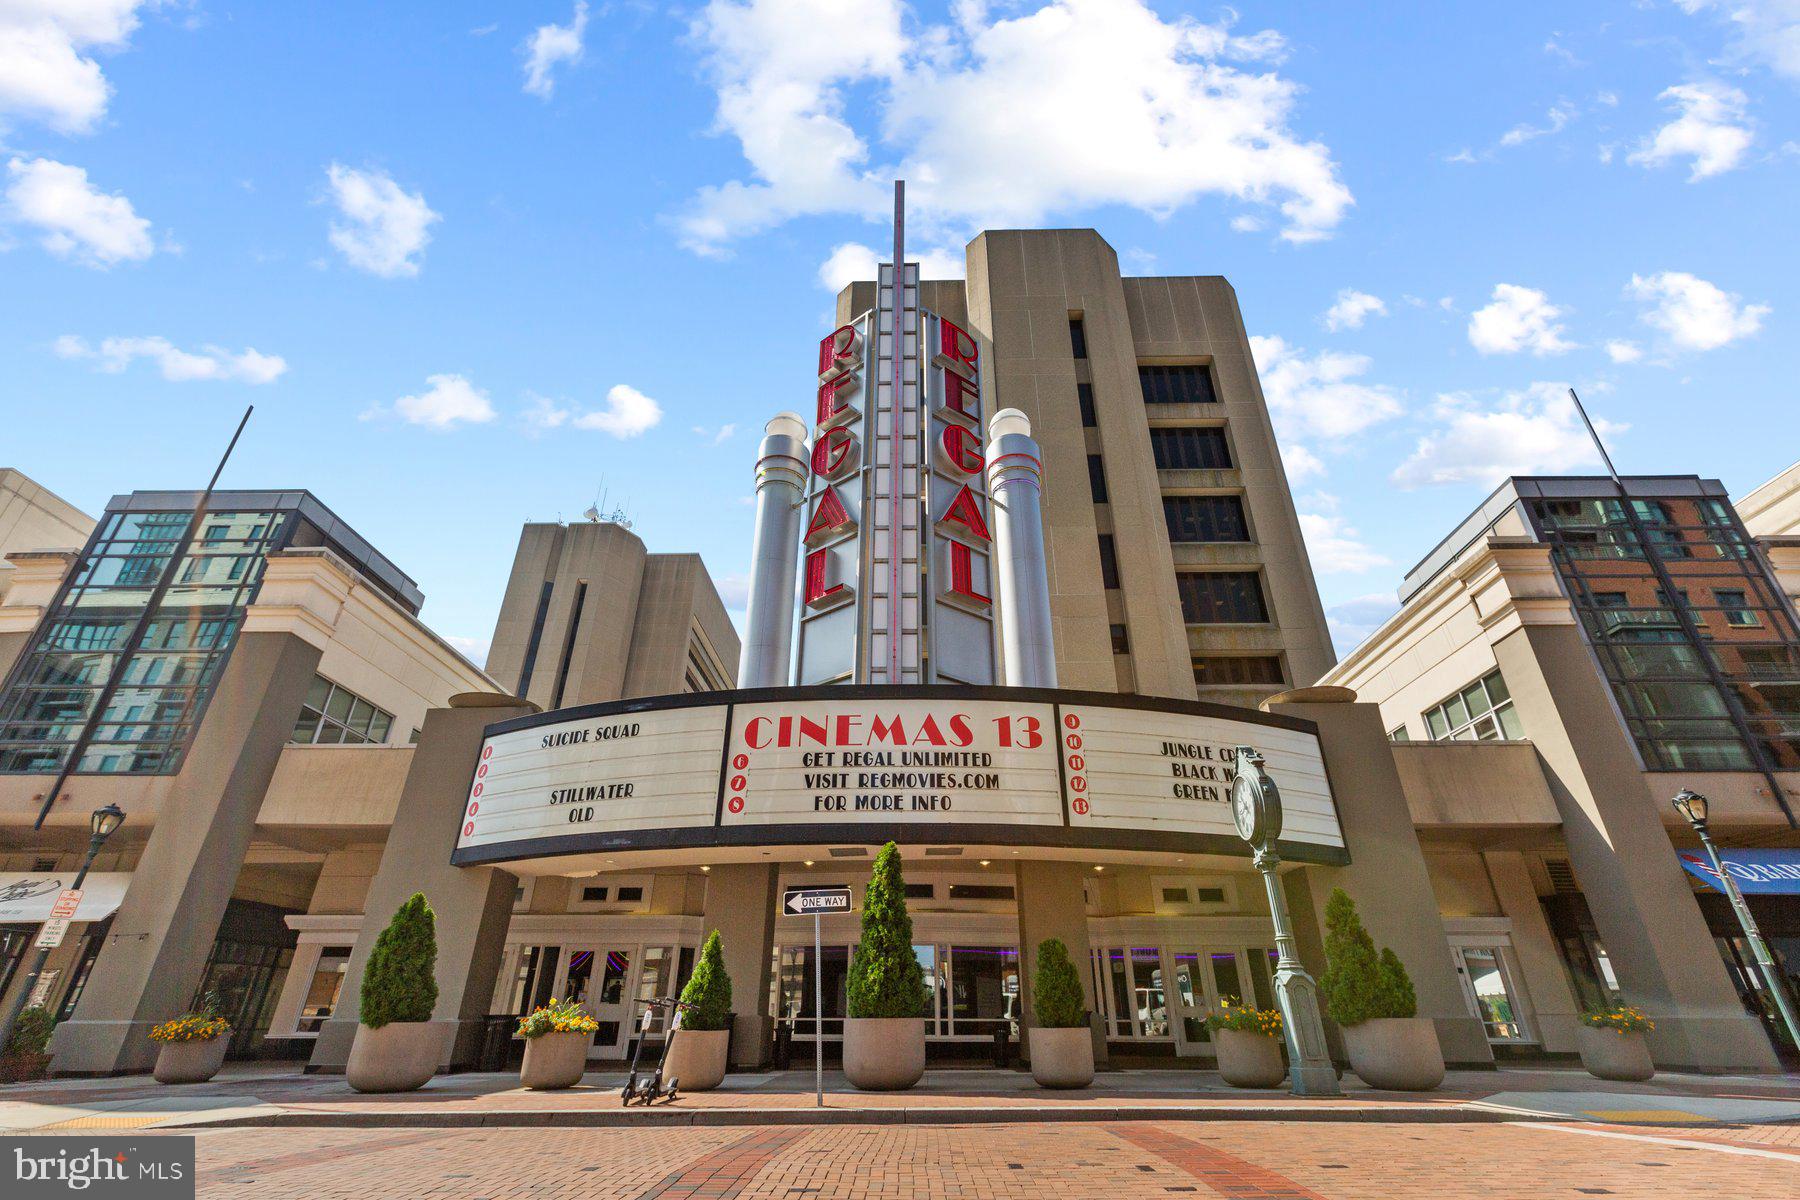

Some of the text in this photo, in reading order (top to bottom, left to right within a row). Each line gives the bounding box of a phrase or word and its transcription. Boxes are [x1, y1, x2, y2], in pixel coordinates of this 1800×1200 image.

[804, 324, 858, 606] REGAL
[938, 316, 993, 605] REGAL
[541, 723, 640, 748] SUICIDE SQUAD
[744, 712, 1043, 749] CINEMAS 13
[802, 752, 992, 767] GET REGAL UNLIMITED
[1160, 741, 1213, 760] JUNGLE
[1172, 763, 1218, 780] BLACK
[804, 774, 1000, 789] VISIT REGMOVIES.COM
[550, 783, 634, 805] STILLWATER
[1173, 783, 1219, 801] GREEN
[814, 796, 952, 811] FOR MORE INFO
[568, 807, 594, 823] OLD
[802, 896, 844, 908] ONE WAY
